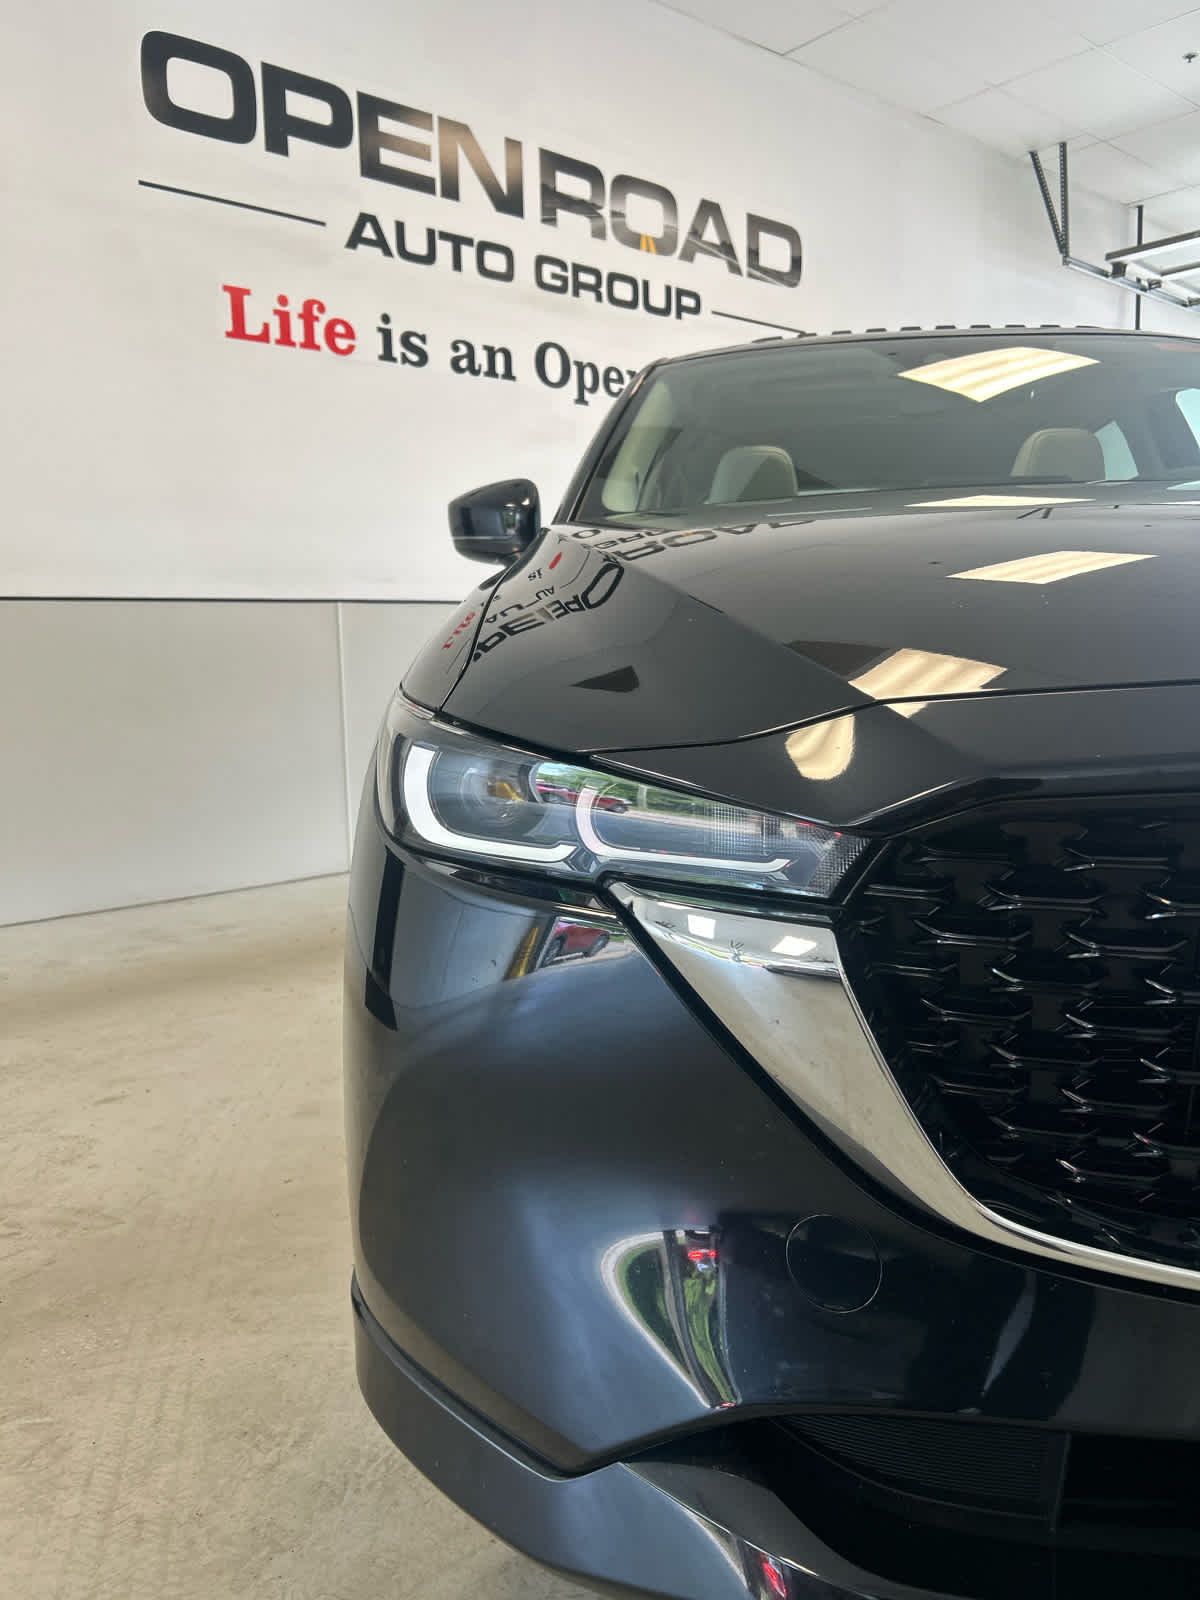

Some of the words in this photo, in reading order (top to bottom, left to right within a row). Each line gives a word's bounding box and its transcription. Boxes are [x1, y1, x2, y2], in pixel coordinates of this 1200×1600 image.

[345, 212, 515, 283] AUTO
[535, 254, 702, 320] GROUP
[222, 284, 357, 357] Life
[377, 313, 429, 368] is
[450, 339, 517, 382] an
[534, 341, 641, 406] Ope
